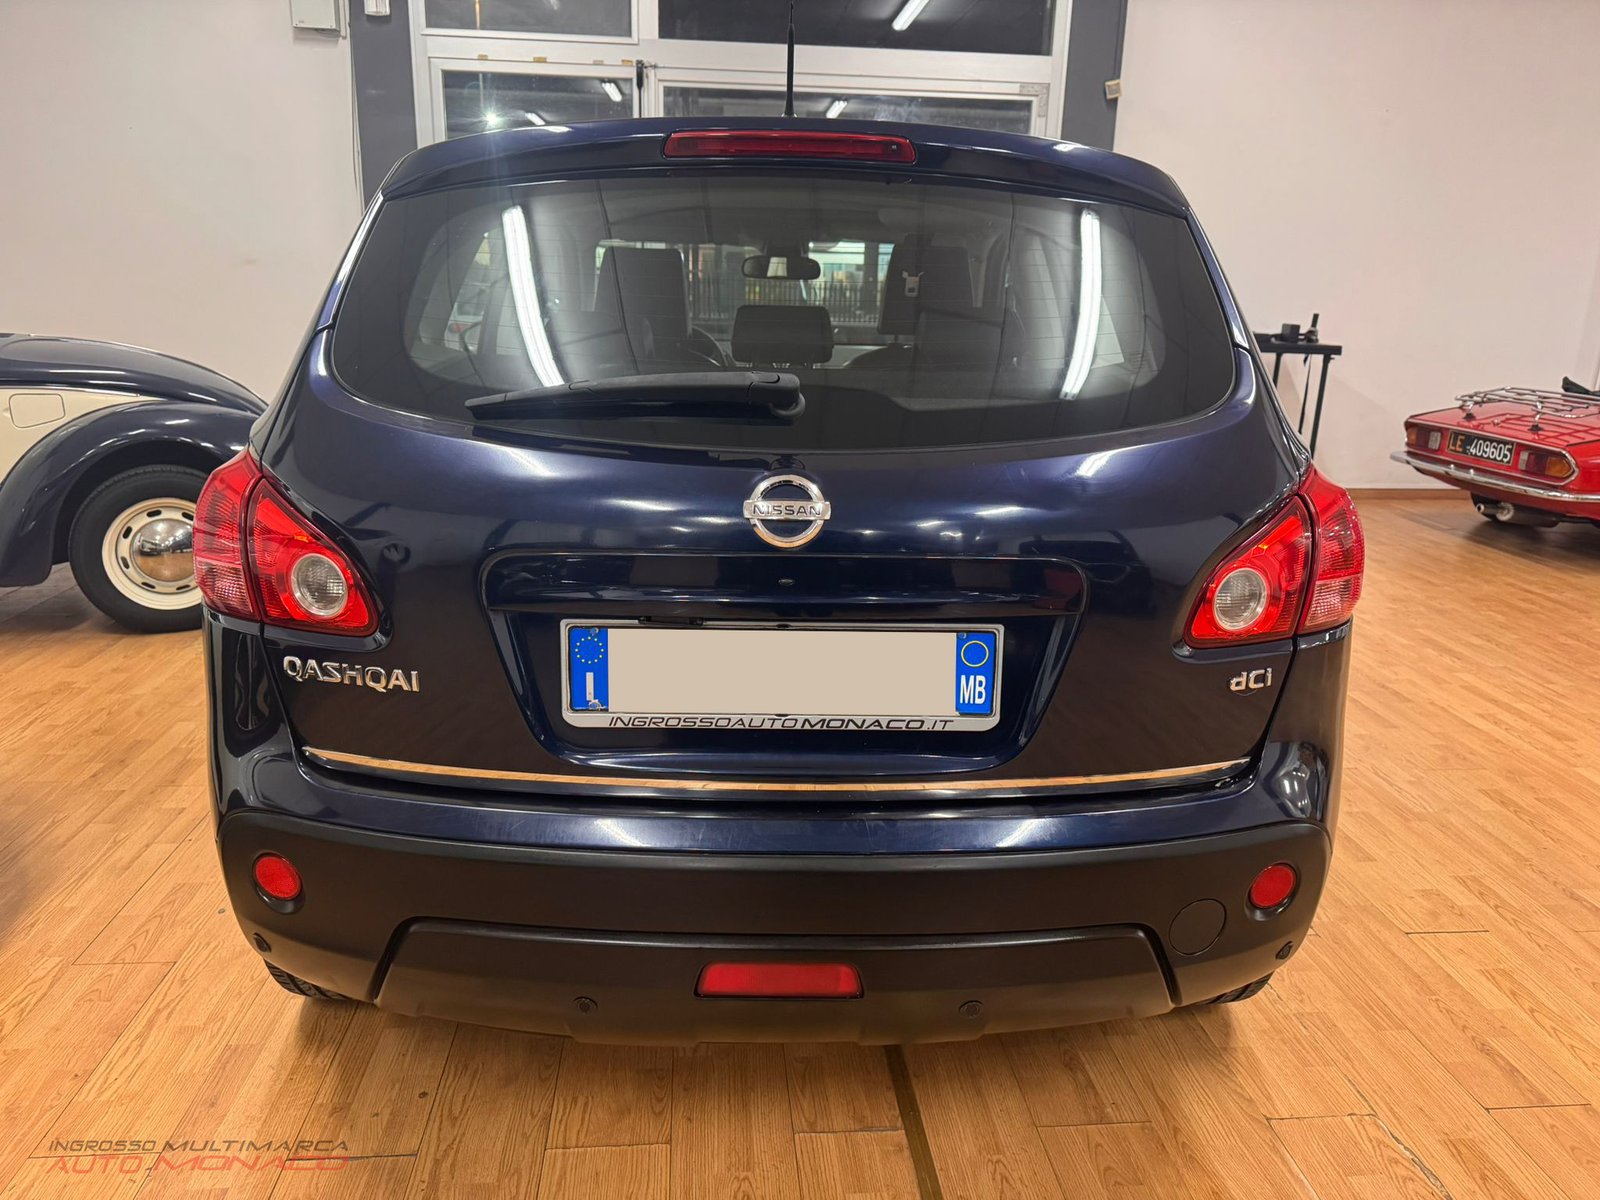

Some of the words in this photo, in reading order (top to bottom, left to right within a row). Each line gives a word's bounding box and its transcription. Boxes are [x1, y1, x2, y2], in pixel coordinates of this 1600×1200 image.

[1449, 432, 1465, 452] LE
[1470, 439, 1512, 462] 409605
[752, 504, 821, 516] NISSAN
[283, 655, 420, 692] QASHQAI
[1230, 667, 1272, 691] dCi
[959, 674, 986, 705] MB
[608, 716, 954, 731] INGROSSOAUTOMONACO.IT
